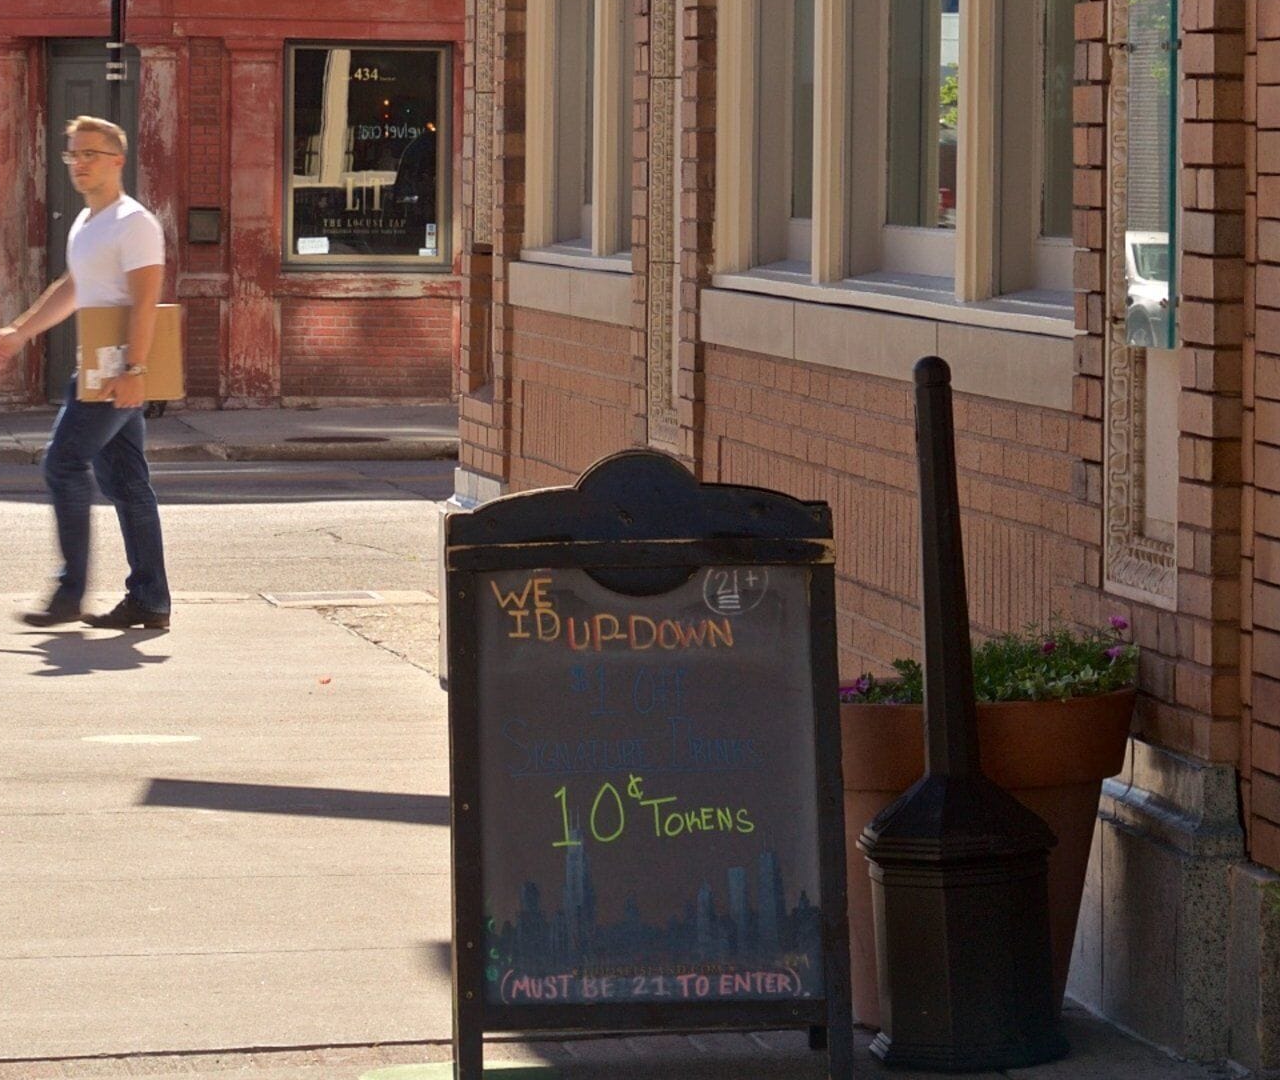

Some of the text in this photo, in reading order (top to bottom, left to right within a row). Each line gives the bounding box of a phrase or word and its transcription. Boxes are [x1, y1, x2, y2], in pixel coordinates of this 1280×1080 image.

[354, 68, 379, 81] 434
[324, 219, 406, 227] THE LOCUST TAP
[490, 577, 553, 610] WE
[507, 608, 561, 641] ID
[500, 970, 574, 1005] (MUST
[632, 975, 671, 997] 21
[676, 974, 709, 997] TO
